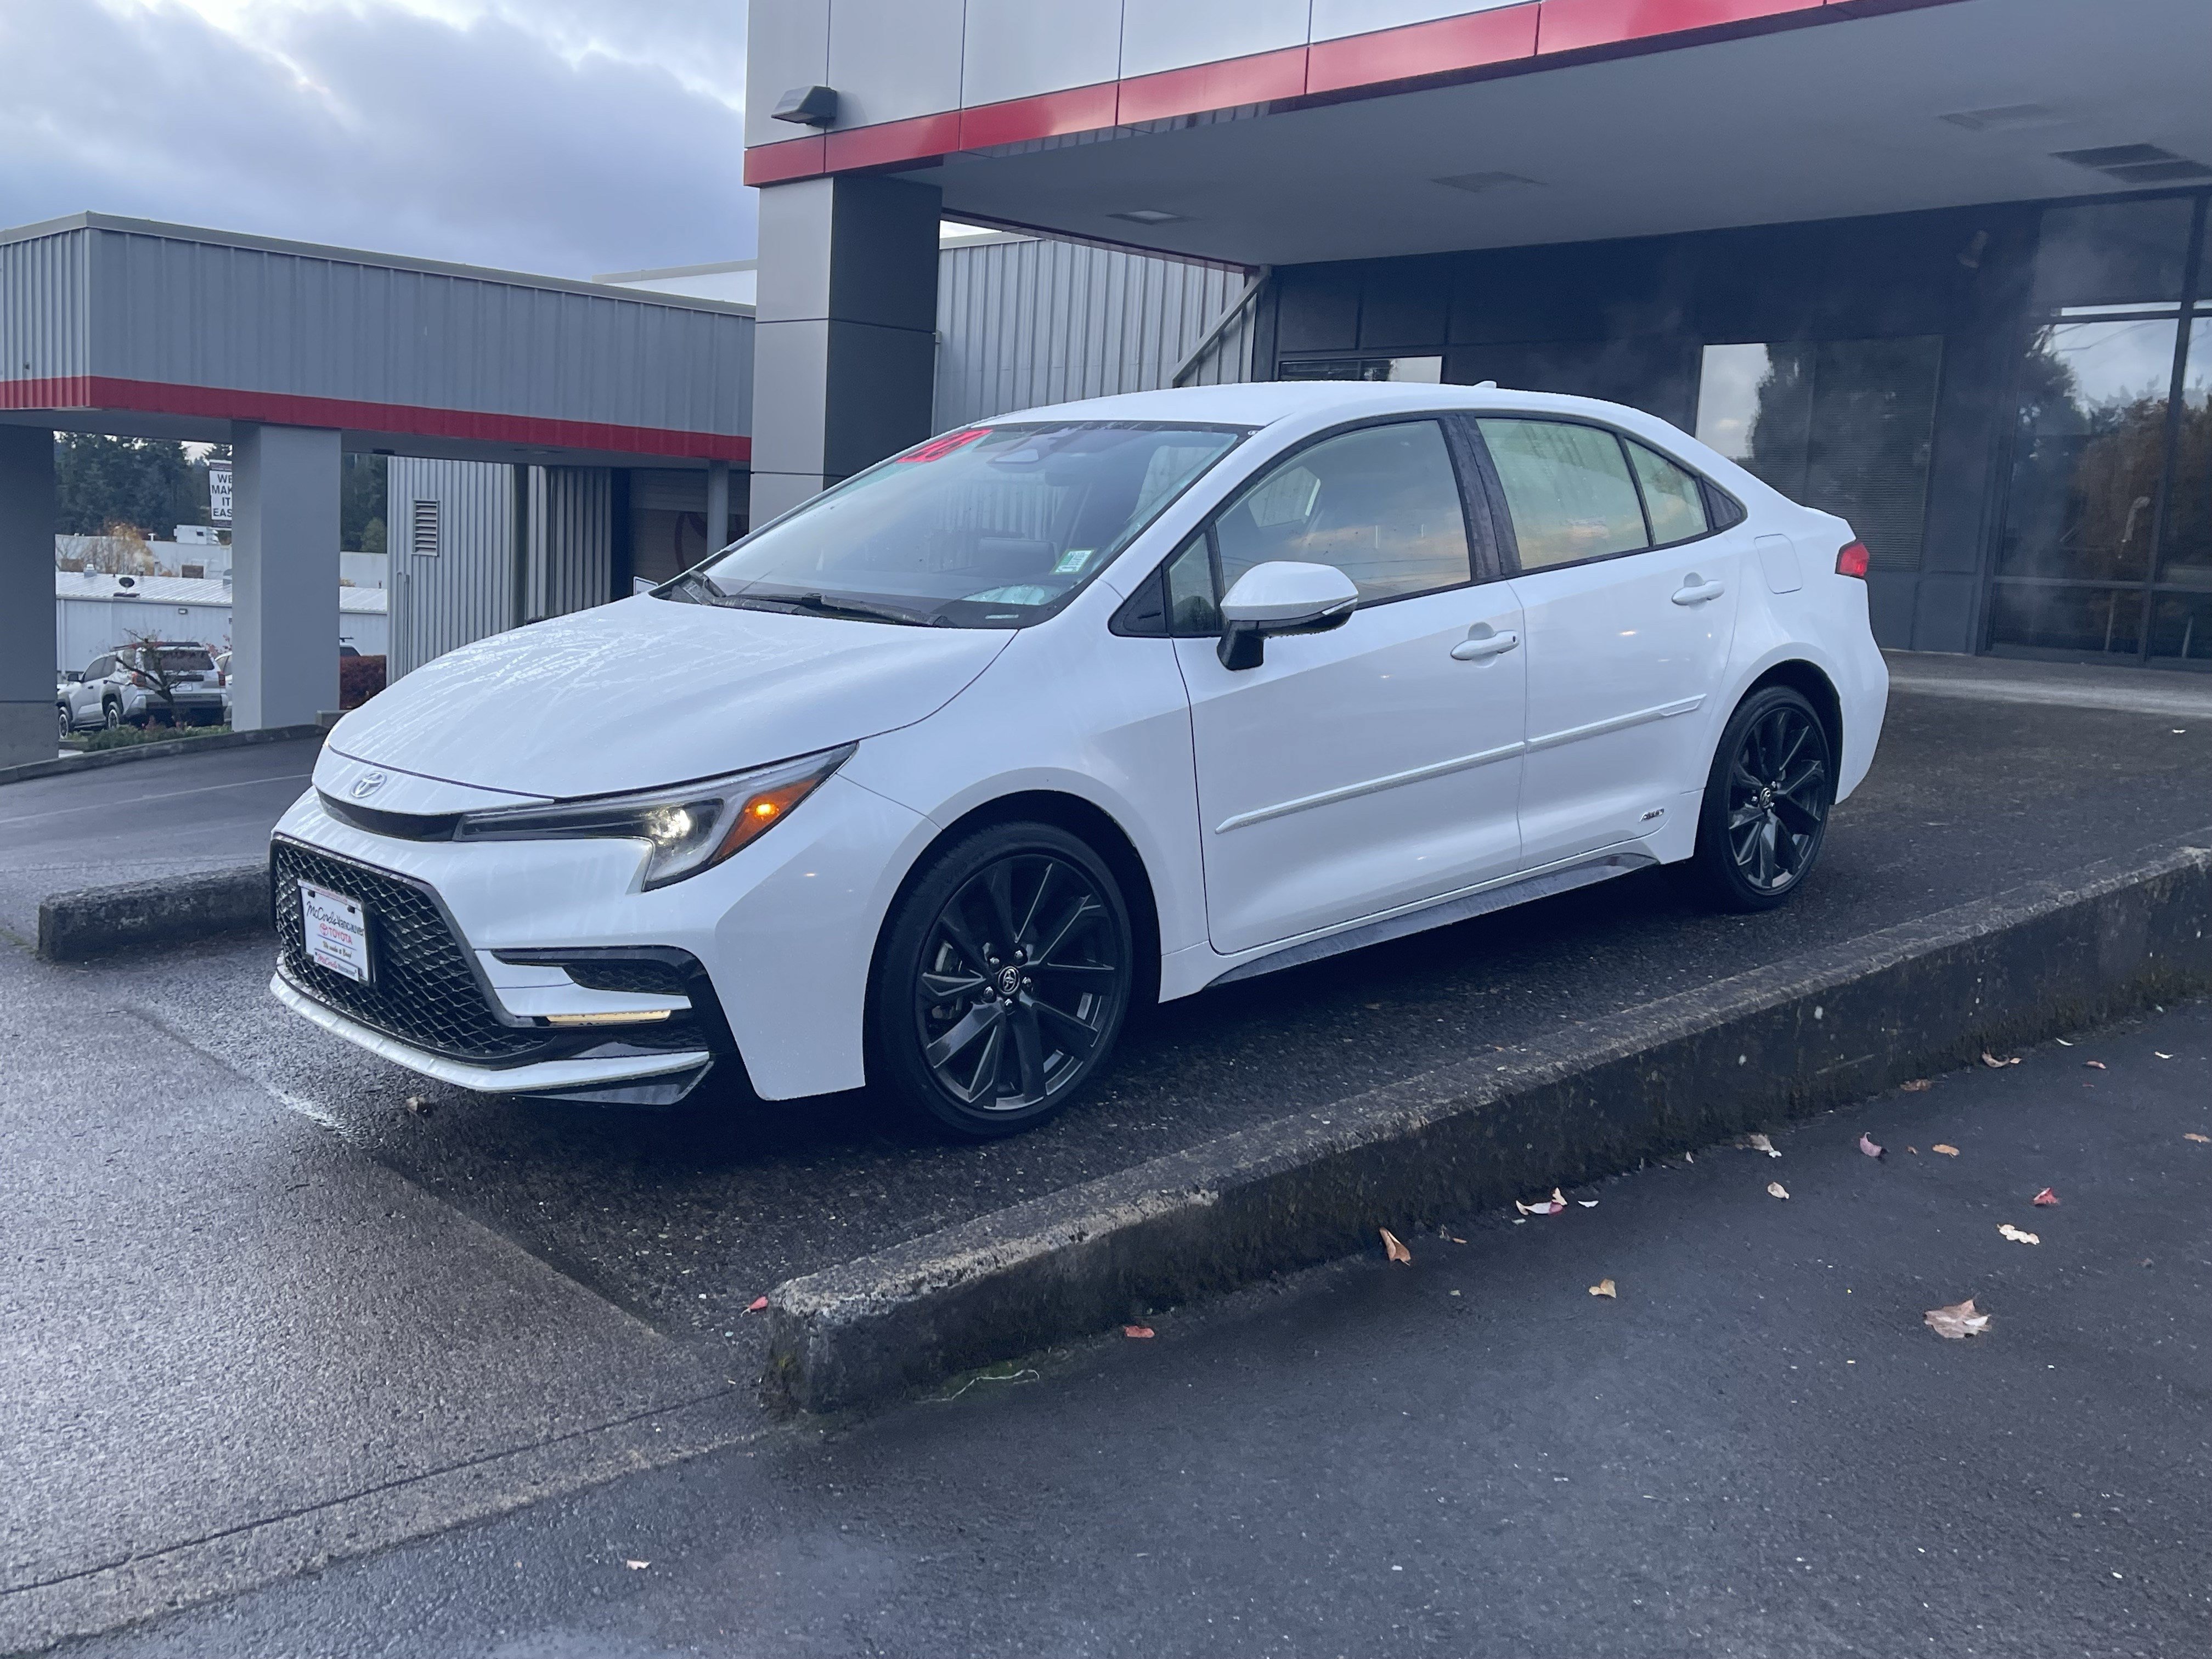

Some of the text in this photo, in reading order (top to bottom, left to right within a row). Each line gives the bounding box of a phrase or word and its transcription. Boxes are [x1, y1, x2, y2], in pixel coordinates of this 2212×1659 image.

[217, 473, 233, 484] WE
[212, 485, 233, 495] MAK
[222, 497, 231, 506] IT
[213, 508, 233, 517] EAS
[329, 927, 353, 945] TOYOTA
